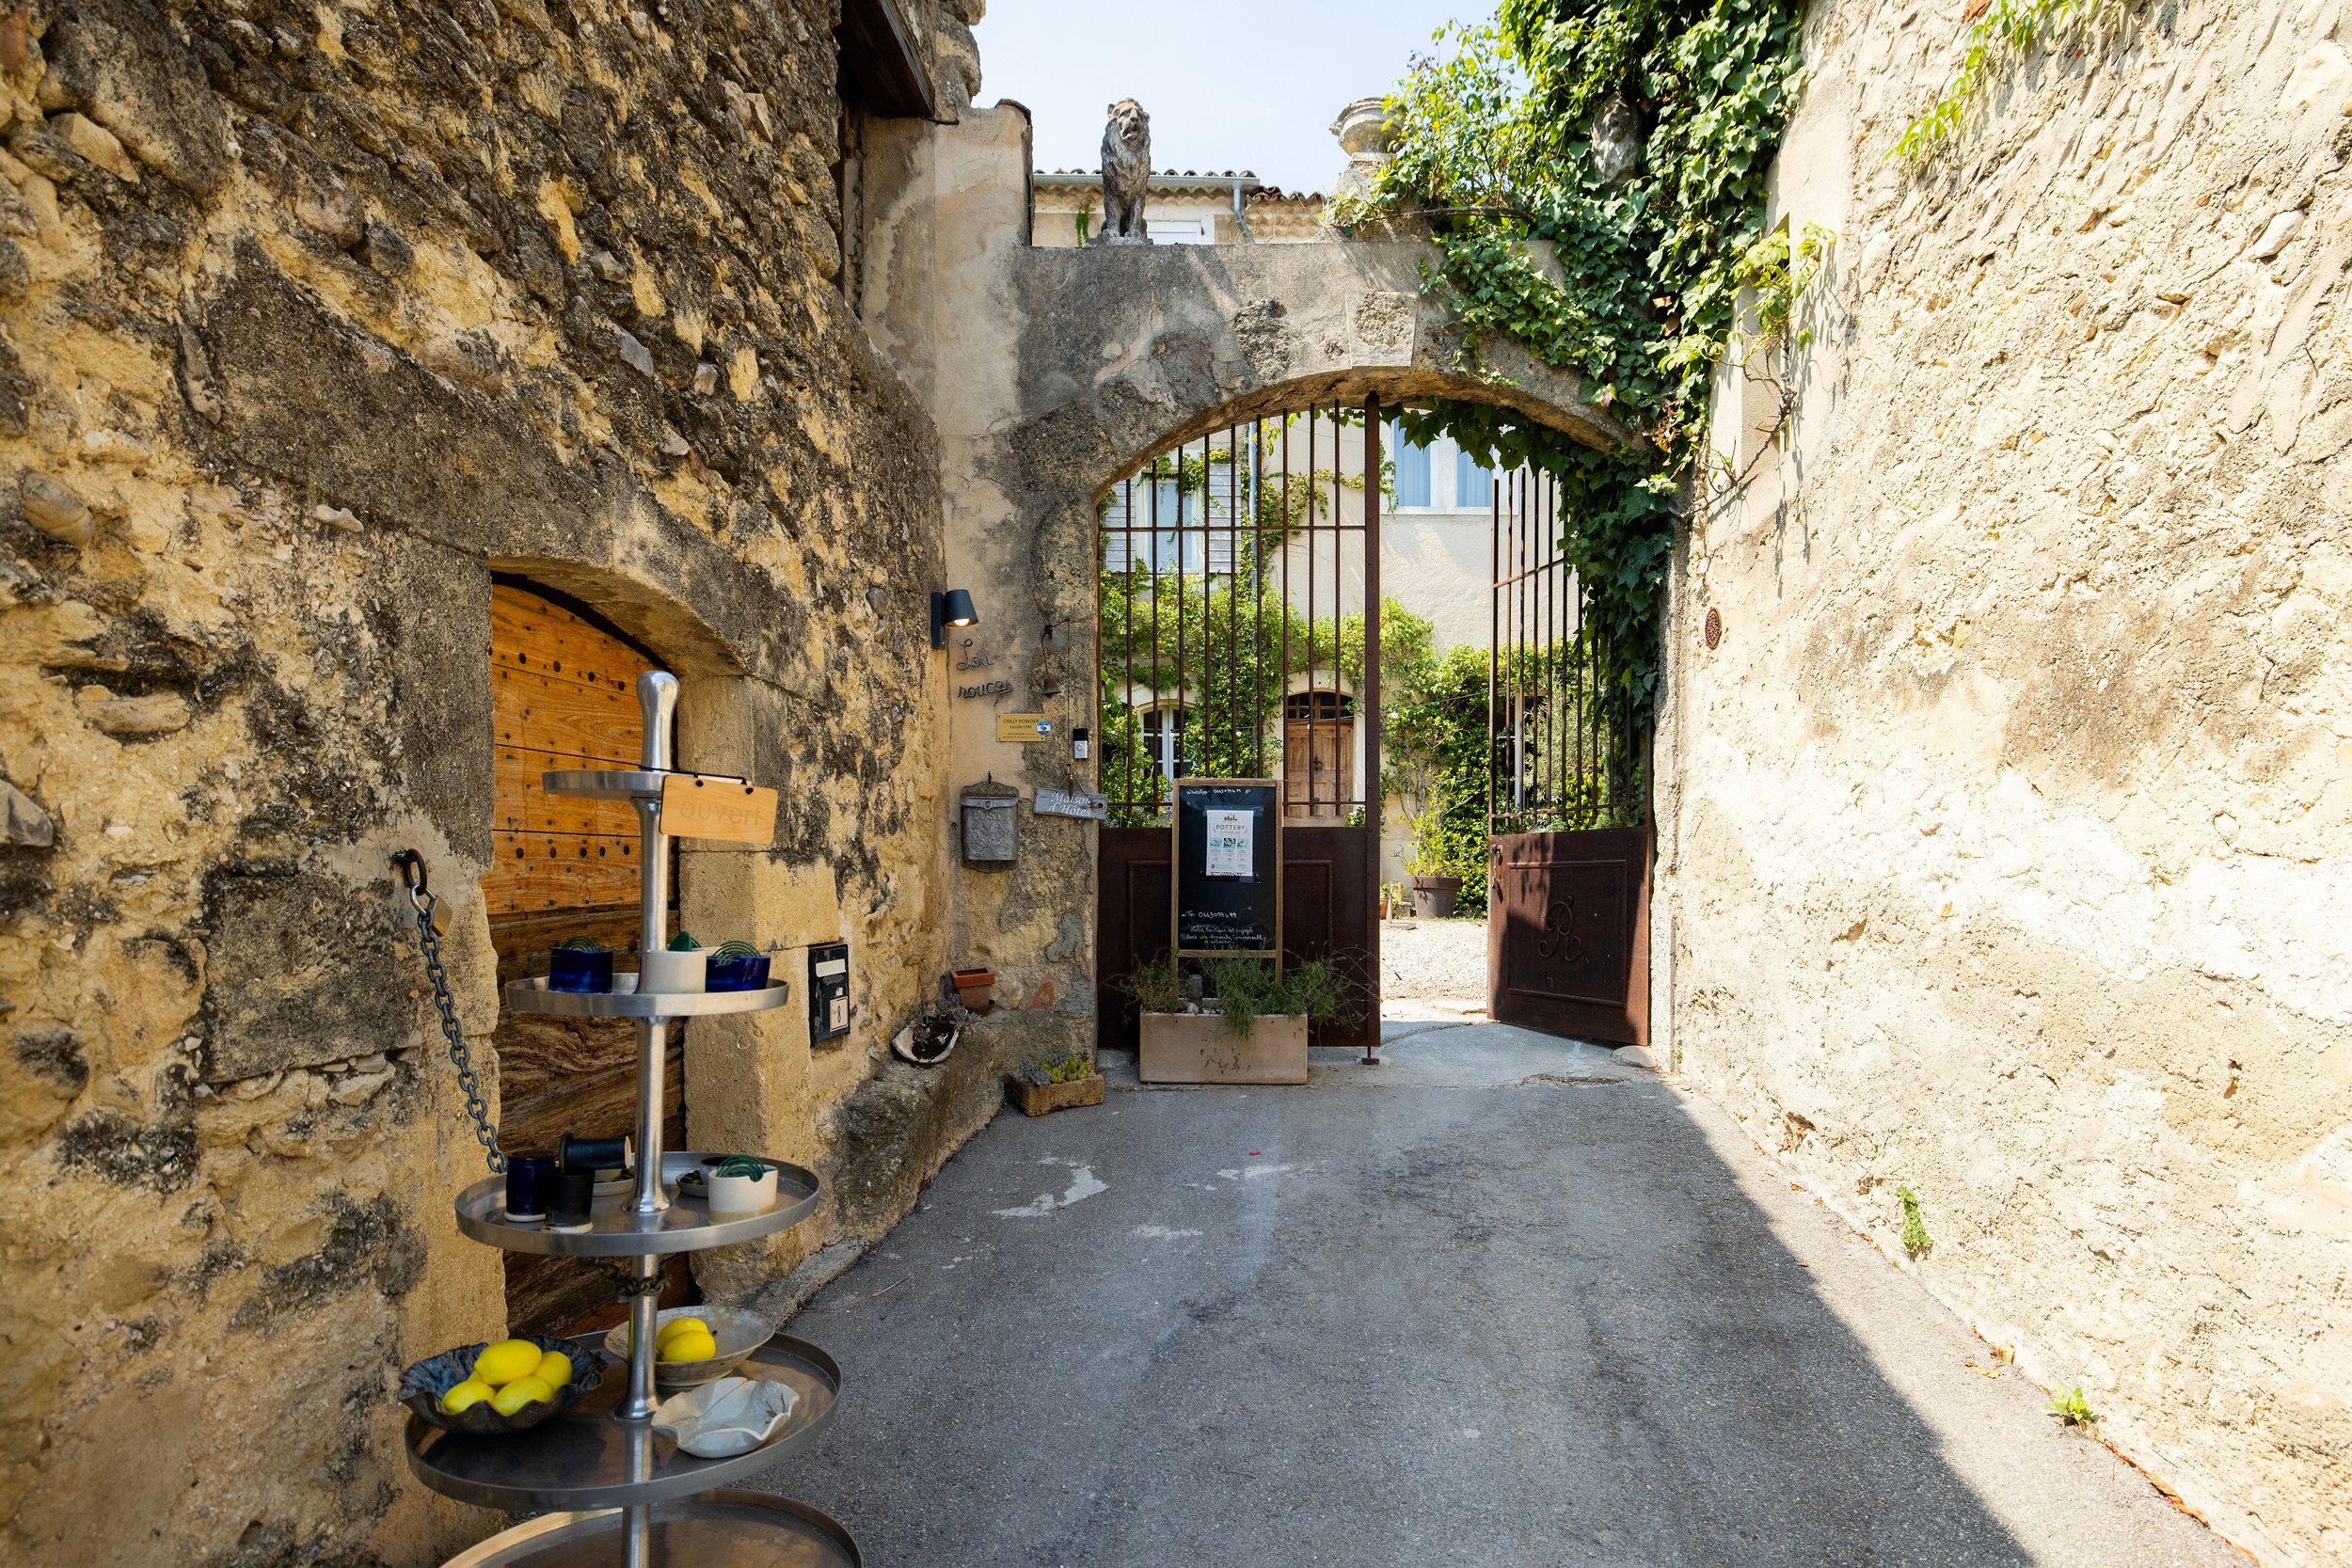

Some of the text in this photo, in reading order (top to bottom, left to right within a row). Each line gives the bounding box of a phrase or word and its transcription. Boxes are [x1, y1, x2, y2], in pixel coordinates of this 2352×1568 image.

[1051, 792, 1090, 804] Maison
[680, 800, 761, 826] ouvert
[1048, 802, 1091, 816] d'Hôtes
